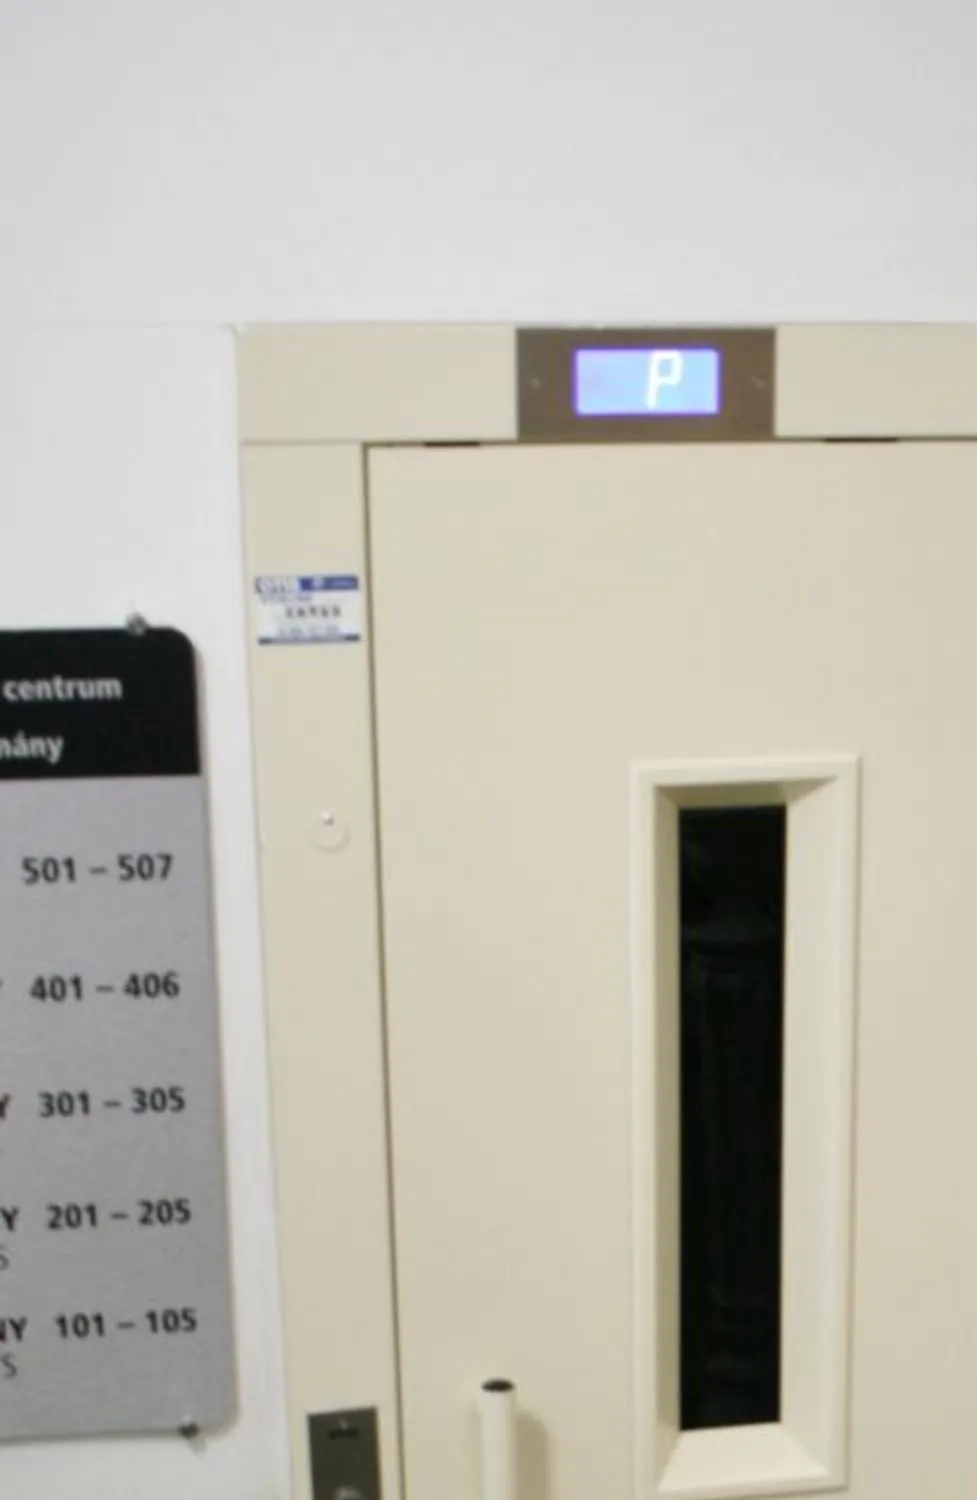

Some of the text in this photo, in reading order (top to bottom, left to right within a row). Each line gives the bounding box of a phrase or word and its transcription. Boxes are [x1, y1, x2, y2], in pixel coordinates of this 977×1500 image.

[644, 348, 683, 409] P
[2, 674, 123, 701] centrum
[22, 857, 76, 885] 501
[117, 854, 173, 881] 507
[30, 975, 82, 1002] 401
[123, 972, 180, 999] 406
[40, 1091, 90, 1118] 301
[133, 1087, 185, 1114] 305
[48, 1204, 97, 1230] 201
[139, 1199, 191, 1225] 205
[56, 1313, 104, 1338] 101
[146, 1308, 197, 1333] 105
